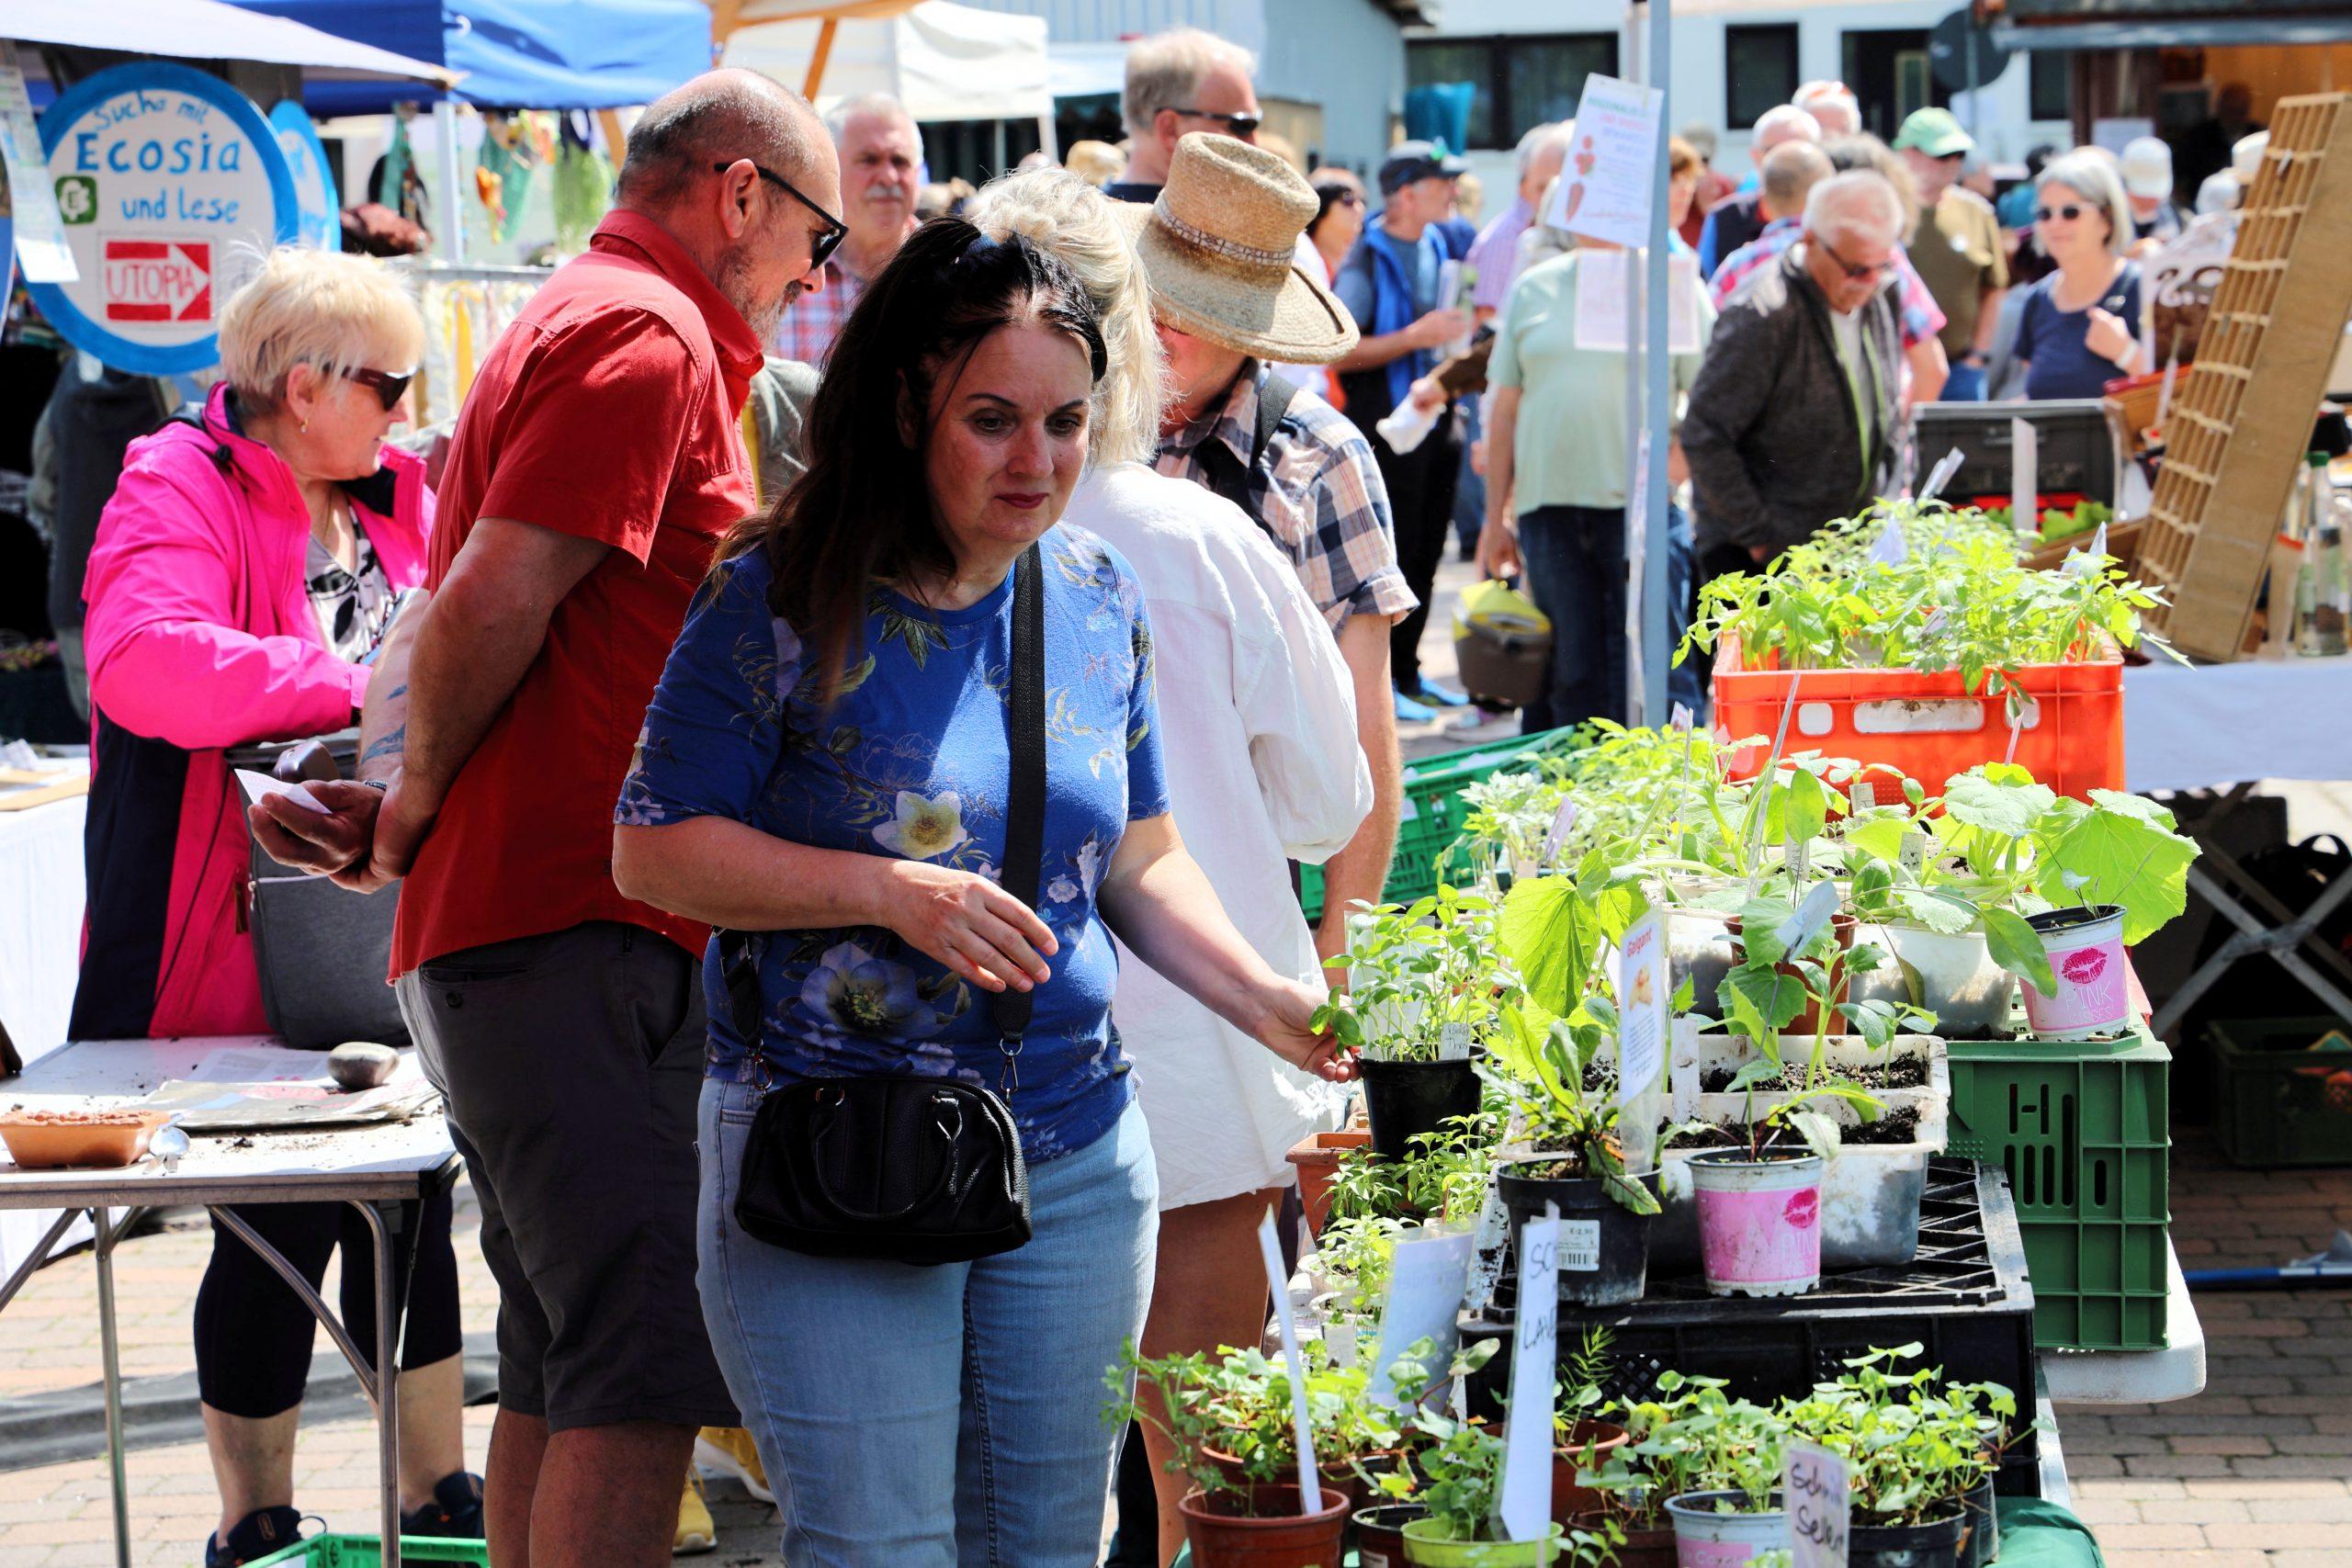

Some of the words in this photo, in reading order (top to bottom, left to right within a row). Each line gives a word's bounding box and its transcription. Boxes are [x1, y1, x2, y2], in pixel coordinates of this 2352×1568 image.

[94, 90, 166, 130] Suche
[177, 100, 209, 125] mit
[76, 131, 241, 175] Ecosia
[121, 187, 167, 220] und
[178, 186, 240, 223] lese
[106, 264, 197, 300] UTOPIA
[1627, 928, 1652, 957] Galgant
[2064, 979, 2114, 1011] PINK
